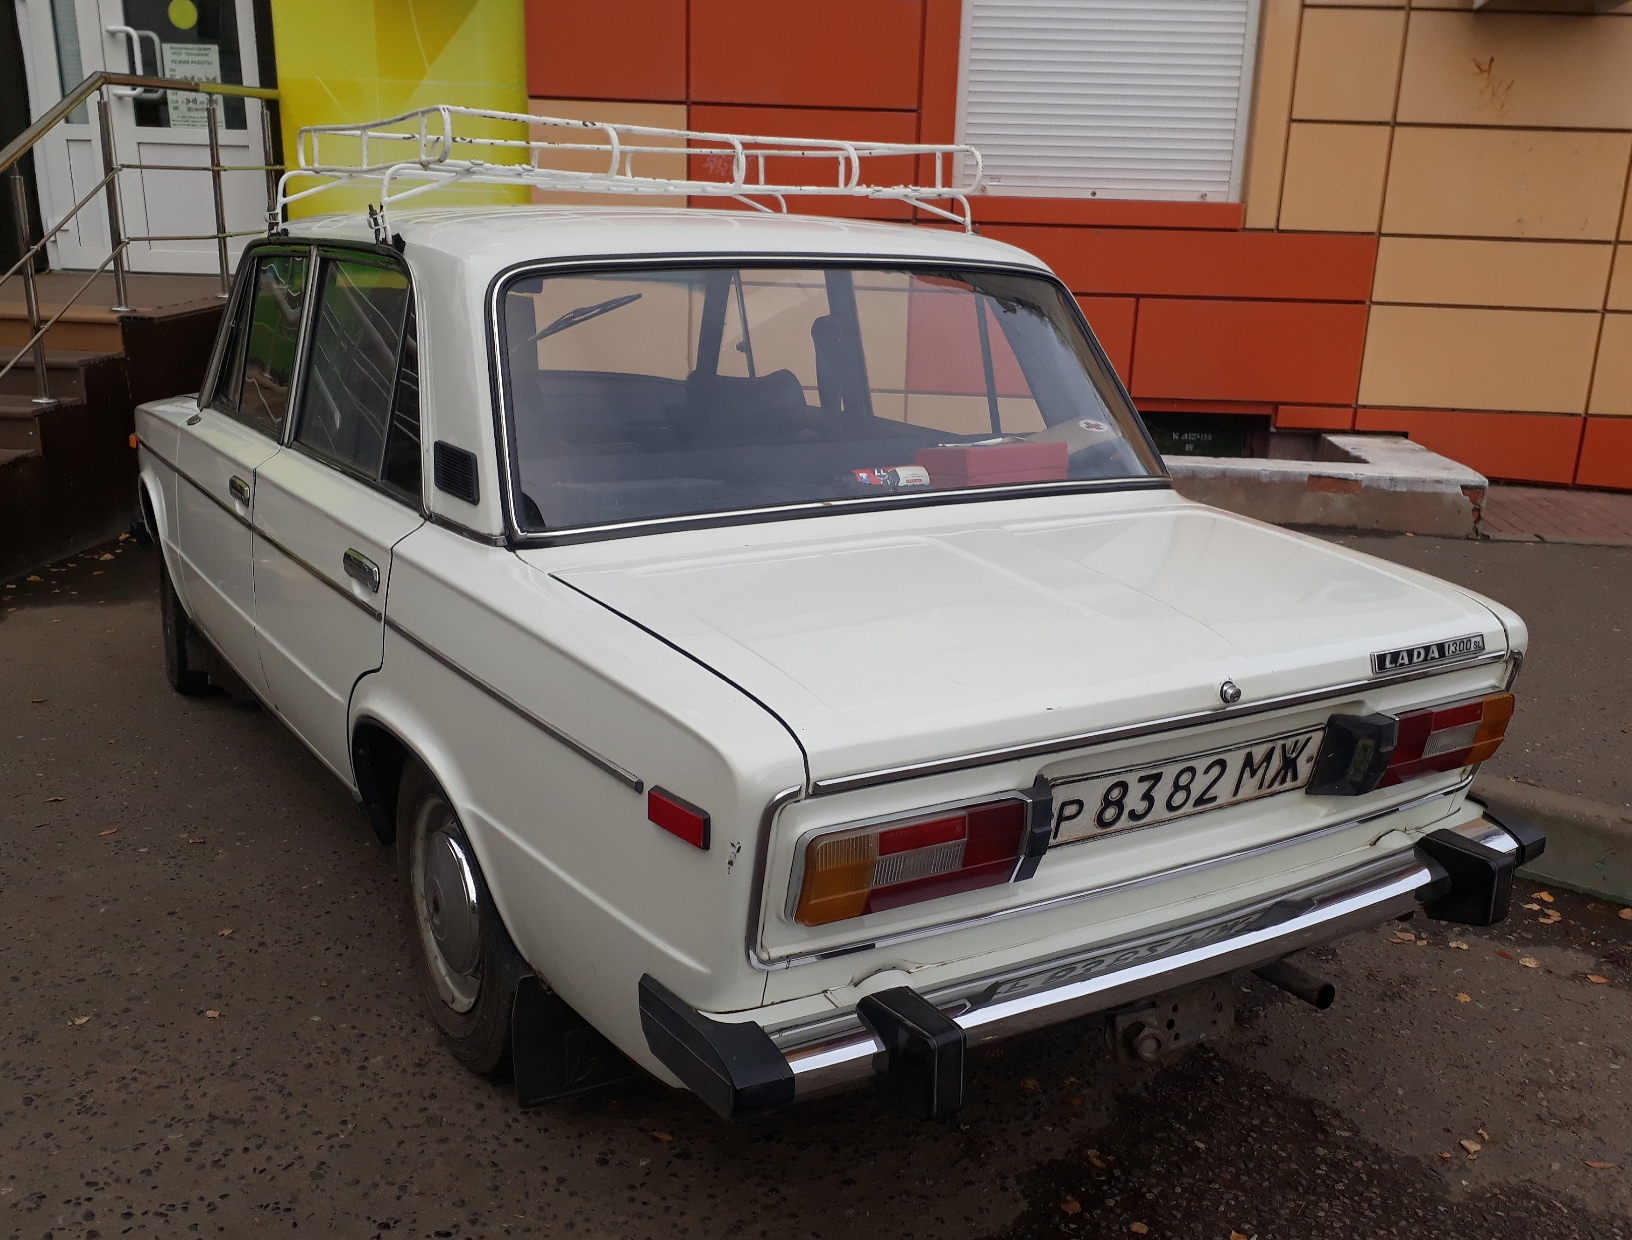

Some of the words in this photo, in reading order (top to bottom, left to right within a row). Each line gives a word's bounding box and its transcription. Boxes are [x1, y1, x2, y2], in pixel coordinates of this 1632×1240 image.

[1384, 644, 1440, 669] LADA
[1447, 639, 1472, 655] 1300
[1473, 640, 1483, 650] SL
[1096, 758, 1227, 829] 8382
[1232, 735, 1313, 798] МЖ
